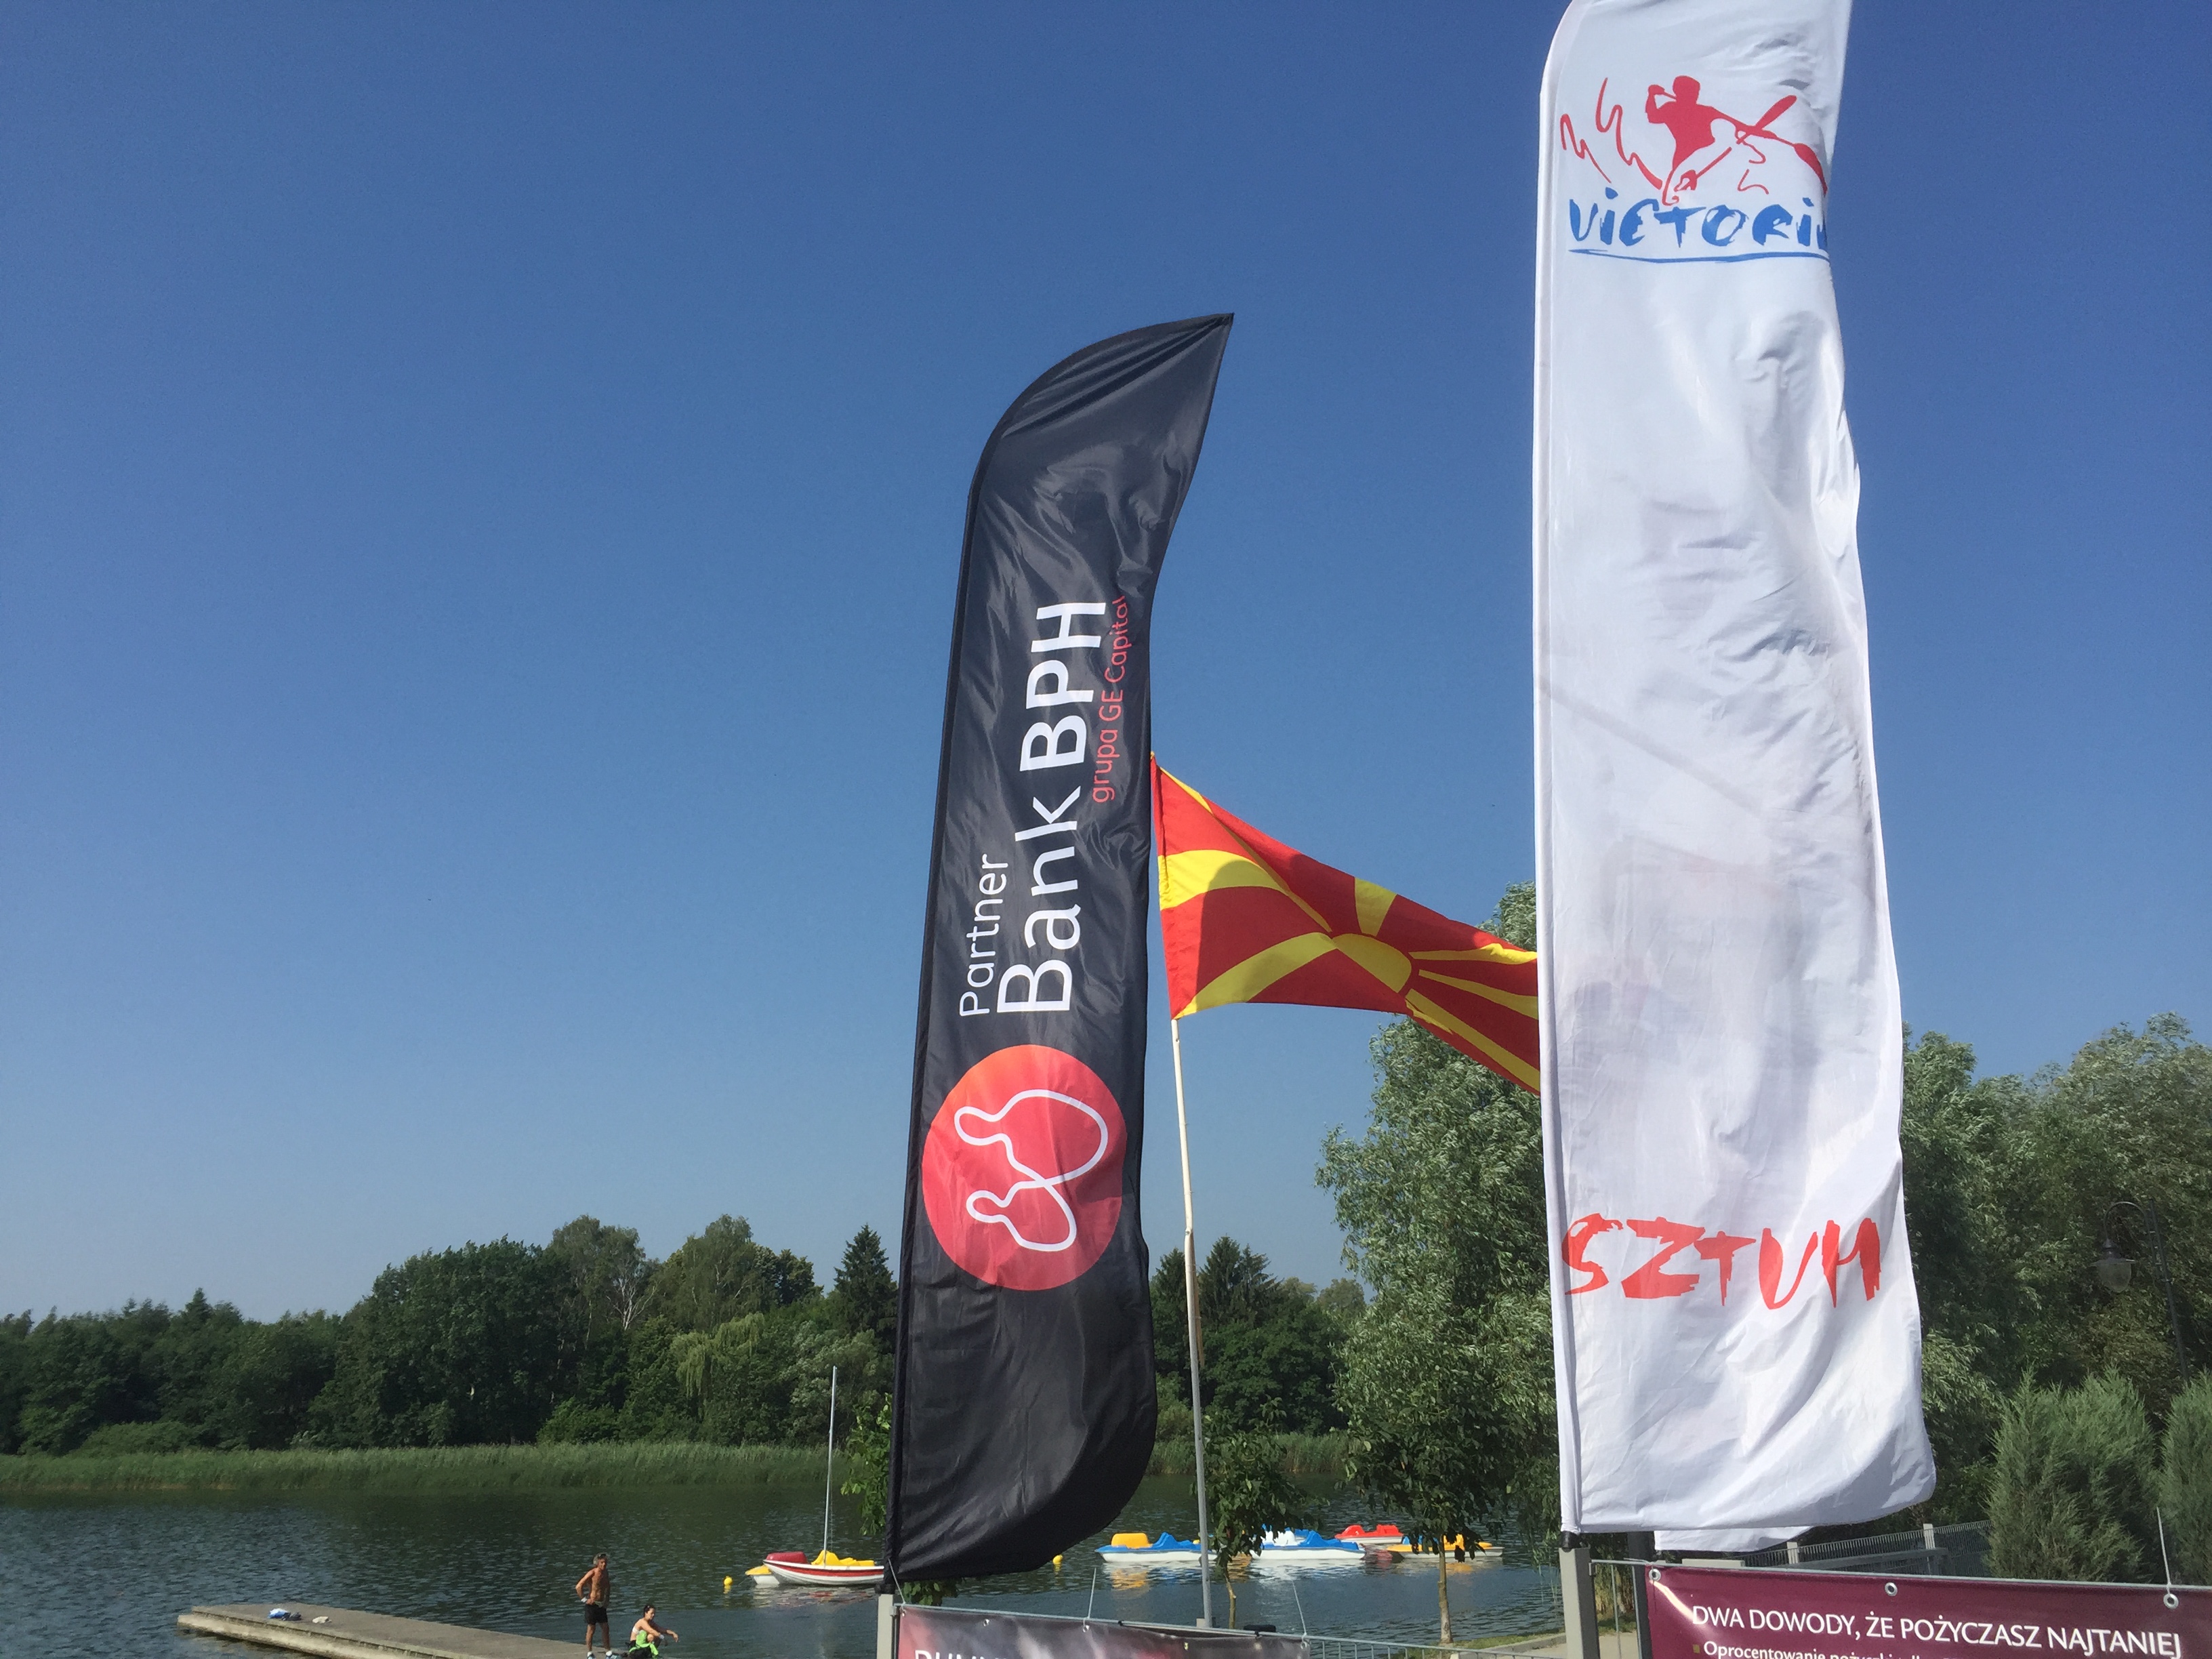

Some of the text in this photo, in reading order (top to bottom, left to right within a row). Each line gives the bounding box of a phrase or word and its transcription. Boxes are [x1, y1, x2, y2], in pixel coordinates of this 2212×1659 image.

[1092, 595, 1132, 803] grupa GE Capital
[997, 602, 1106, 1012] Bank BPH
[960, 854, 1008, 1016] Partner
[1693, 1605, 2182, 1659] DWA DOWODY, ŻE POŻYCZASZ NAJTANIEJ
